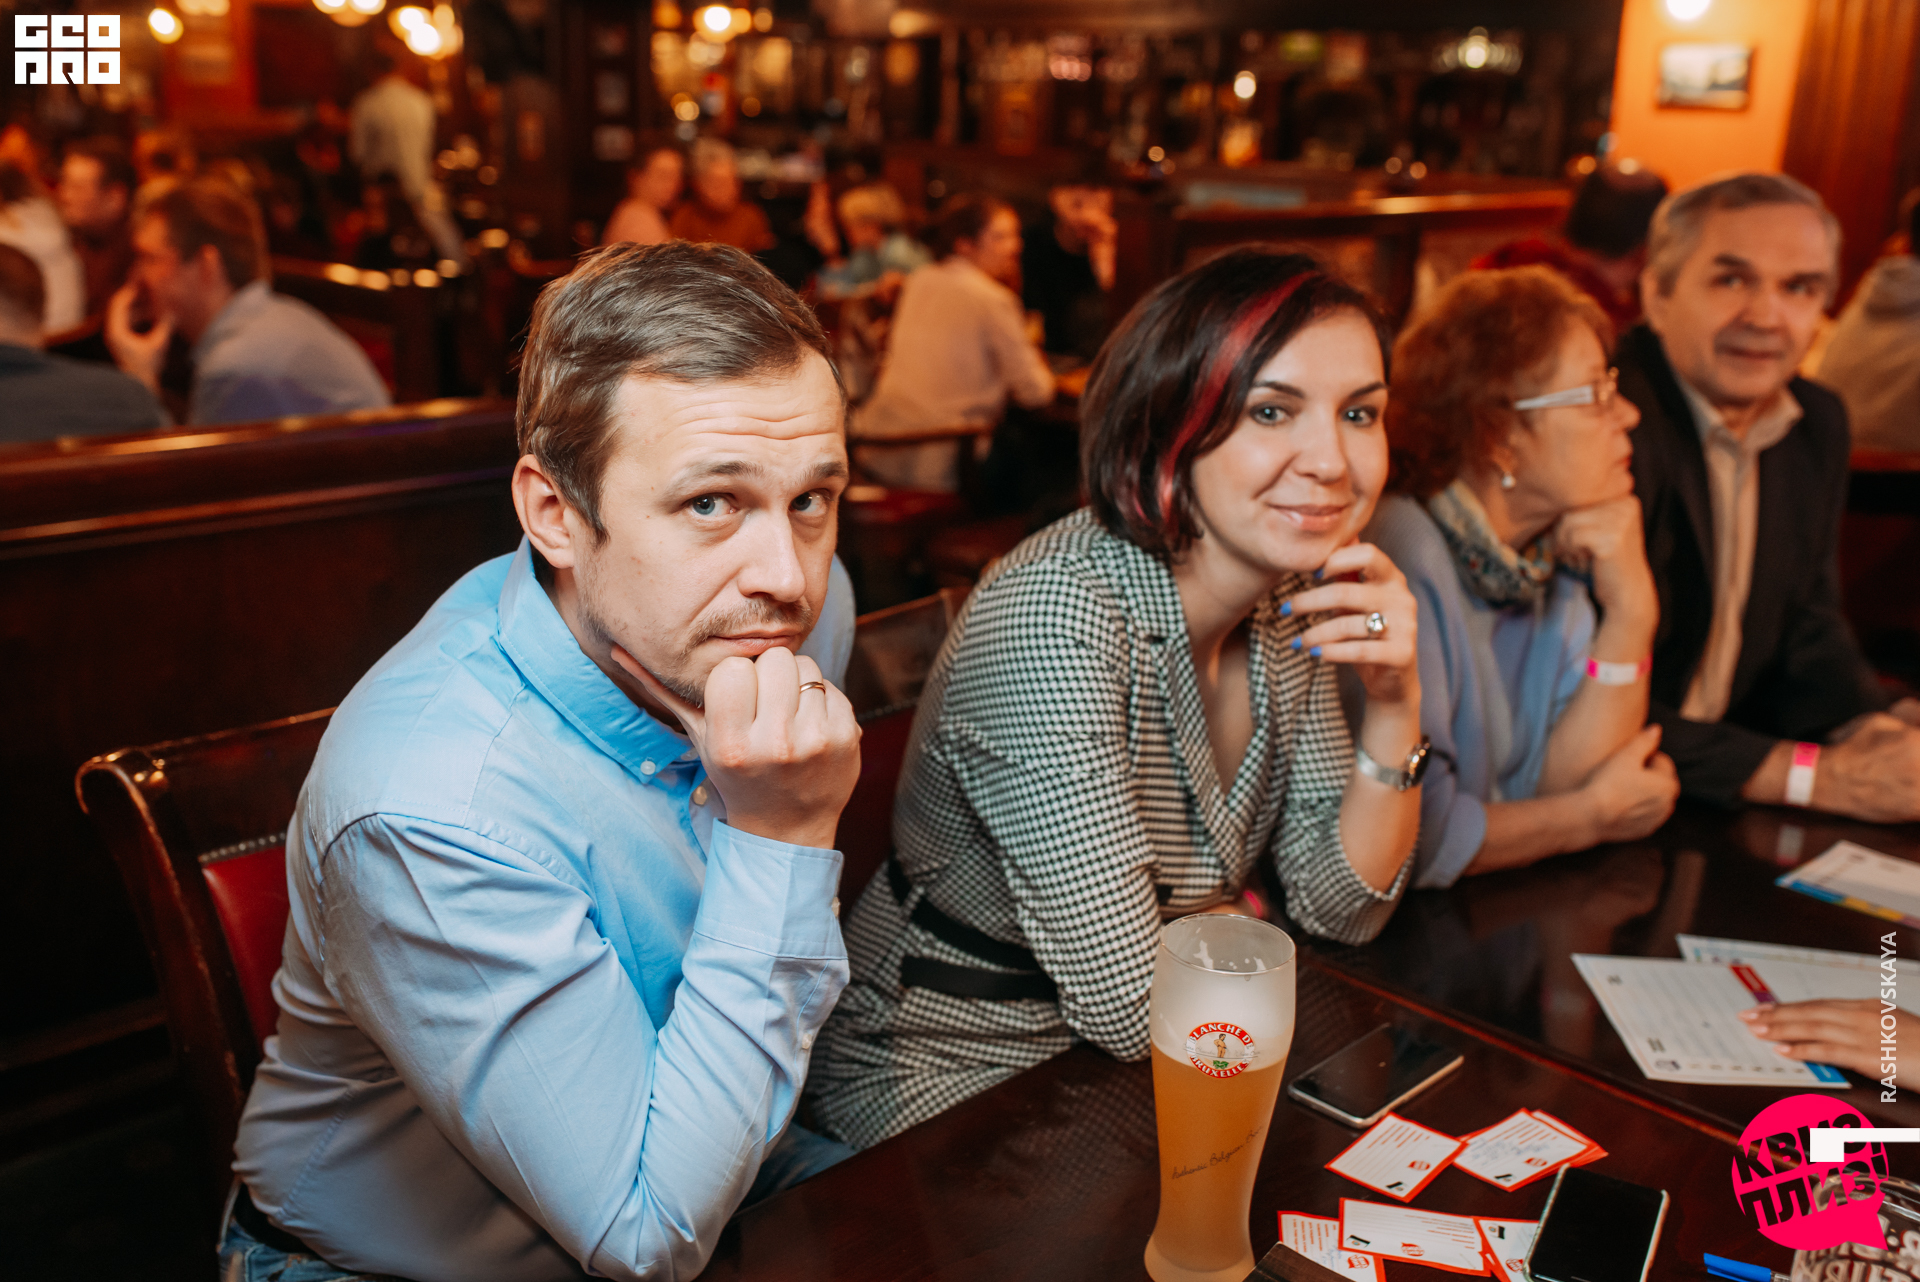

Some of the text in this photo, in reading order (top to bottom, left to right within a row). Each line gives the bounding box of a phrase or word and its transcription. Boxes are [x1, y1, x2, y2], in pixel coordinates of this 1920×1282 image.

[1189, 1023, 1255, 1050] BLANCHE DE
[1209, 1146, 1244, 1167] Belgian
